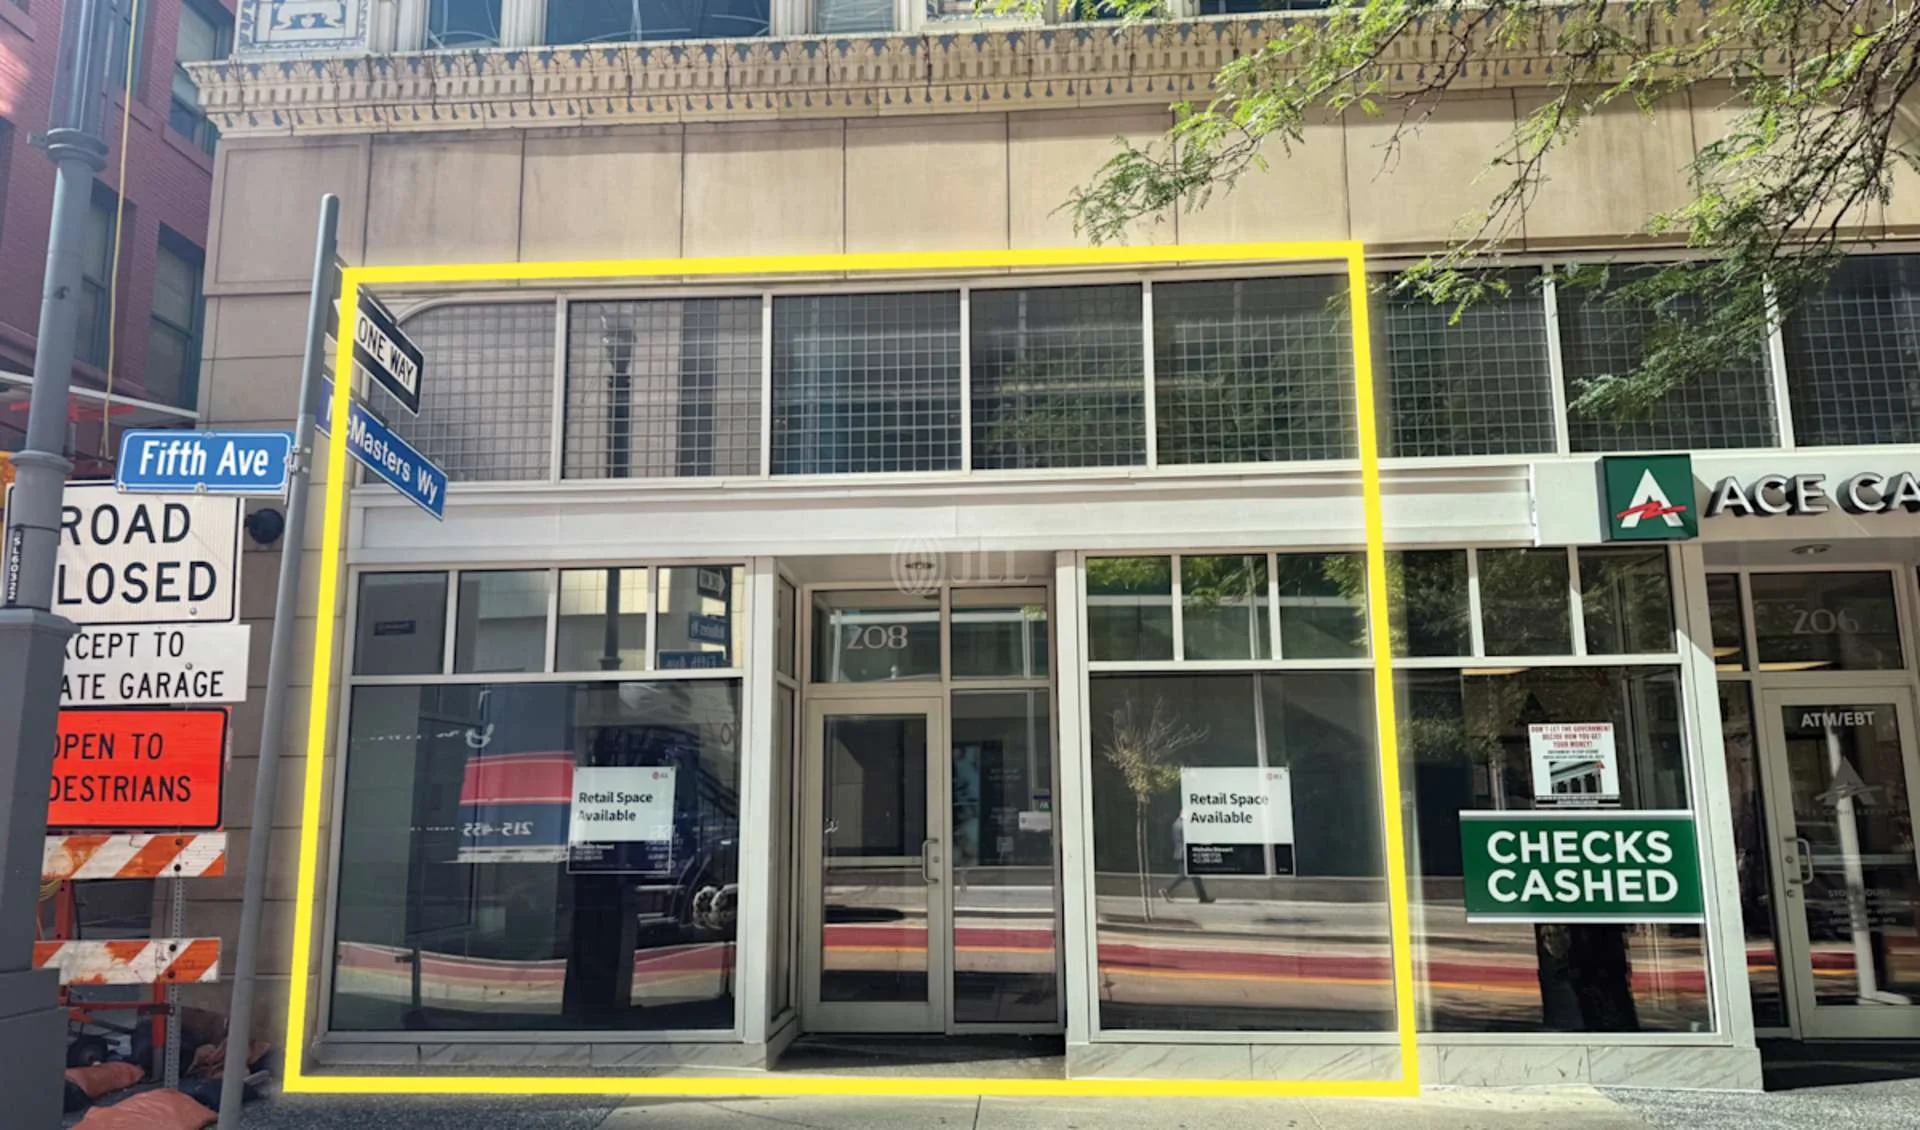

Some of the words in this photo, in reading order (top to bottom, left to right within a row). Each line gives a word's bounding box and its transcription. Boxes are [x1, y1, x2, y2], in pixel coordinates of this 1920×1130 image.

[357, 316, 384, 362] ONE
[389, 340, 415, 387] WAY
[139, 440, 206, 476] Fifth
[216, 443, 269, 477] Ave
[327, 396, 411, 482] Masters
[417, 465, 439, 506] Wy
[1706, 473, 1830, 516] ACE
[60, 503, 191, 545] ROAD
[154, 631, 184, 657] TO
[847, 625, 908, 650] 208
[119, 671, 224, 699] GARAGE
[1801, 711, 1876, 728] ATM/EBT
[132, 733, 163, 759] TO
[578, 792, 614, 803] Retail
[616, 792, 653, 806] Space
[1189, 792, 1227, 805] Retail
[1229, 792, 1269, 808] Space
[578, 809, 637, 822] Available
[1190, 810, 1254, 824] Available
[1487, 831, 1673, 864] CHECKS
[1487, 869, 1679, 902] CASHED
